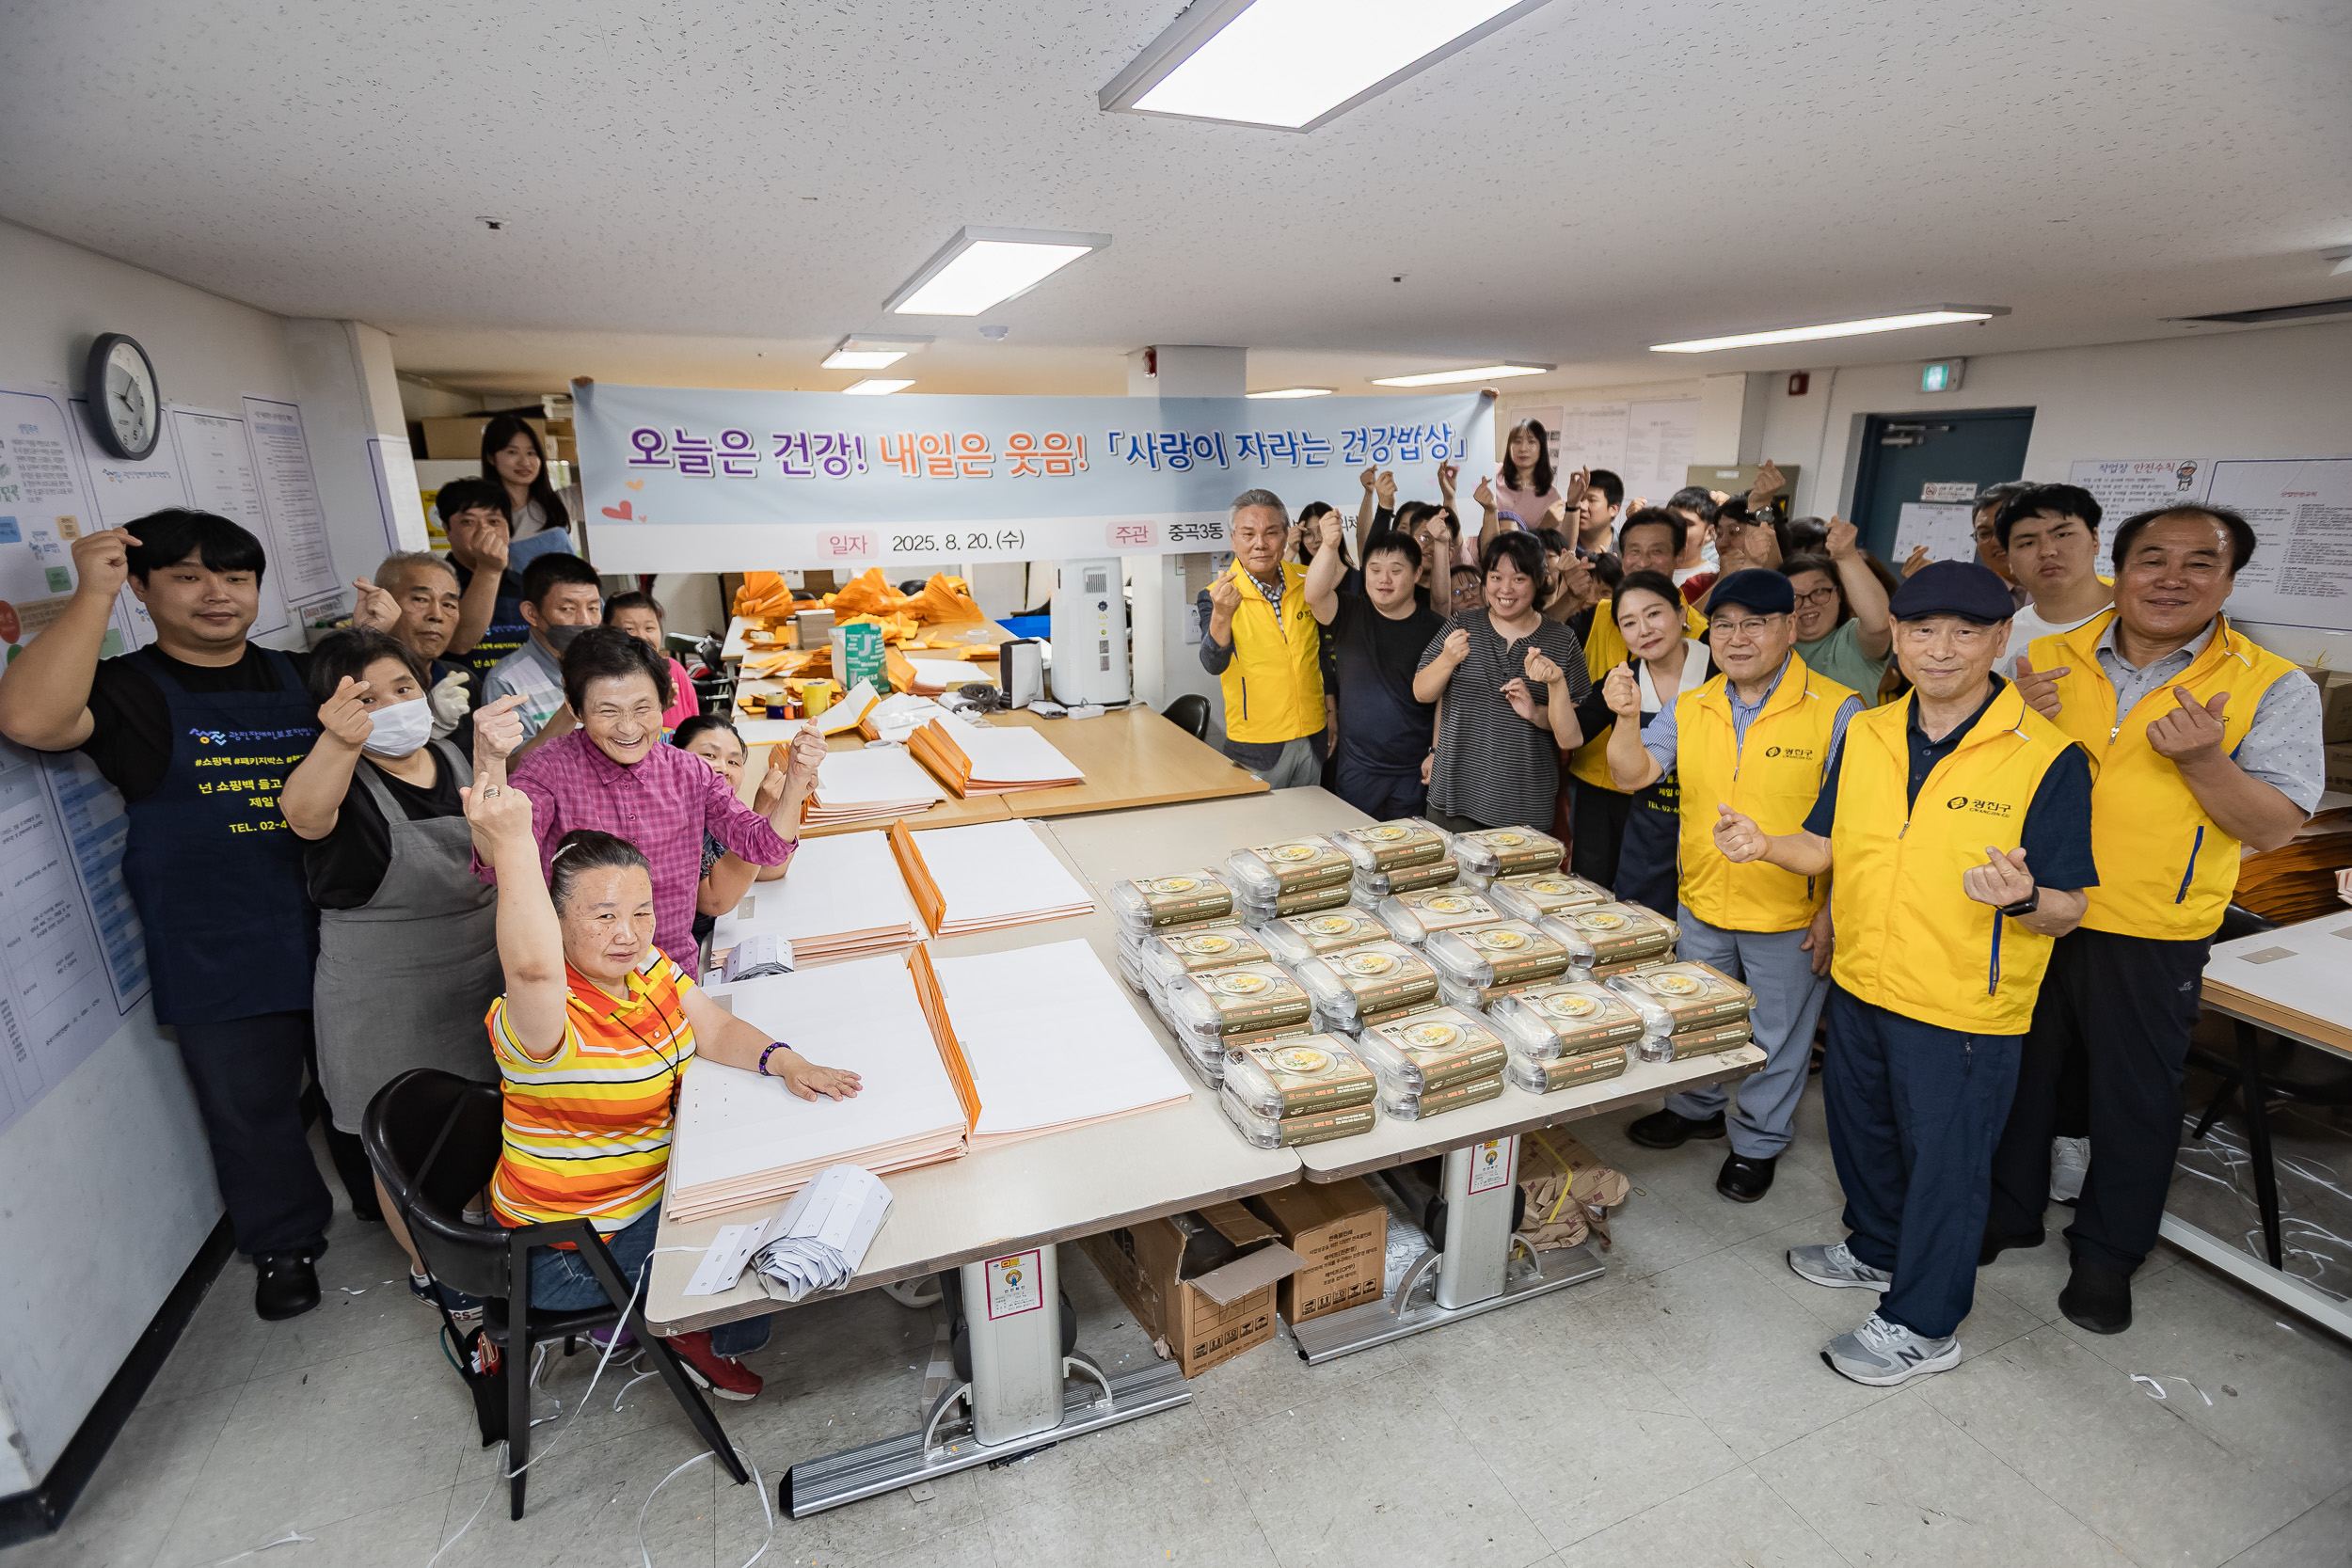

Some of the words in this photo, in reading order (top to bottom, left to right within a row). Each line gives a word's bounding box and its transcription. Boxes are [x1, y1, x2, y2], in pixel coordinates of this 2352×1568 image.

[628, 426, 758, 476] 오늘은
[771, 431, 866, 477] 건강!
[878, 431, 993, 477] 내일은
[1004, 432, 1089, 476] 웃음!
[1108, 430, 1228, 470] 「사랑이
[1234, 430, 1331, 467] 자라는
[1341, 421, 1466, 464] 건강밥상」
[1115, 525, 1150, 544] 주관
[1168, 522, 1225, 542] 중곡3동
[829, 534, 867, 555] 일자
[892, 534, 940, 552] 2025.
[945, 533, 961, 550] 8.
[966, 532, 993, 550] 20.
[995, 529, 1025, 550] (수)
[195, 756, 232, 767] #쇼핑백
[233, 756, 284, 767] #패키지박스
[199, 782, 213, 794] 넌
[216, 779, 255, 792] 쇼핑백
[248, 797, 275, 807] 제일
[1972, 799, 2011, 813] 광진구
[229, 823, 258, 833] TEL.
[1896, 1345, 1925, 1369] N
